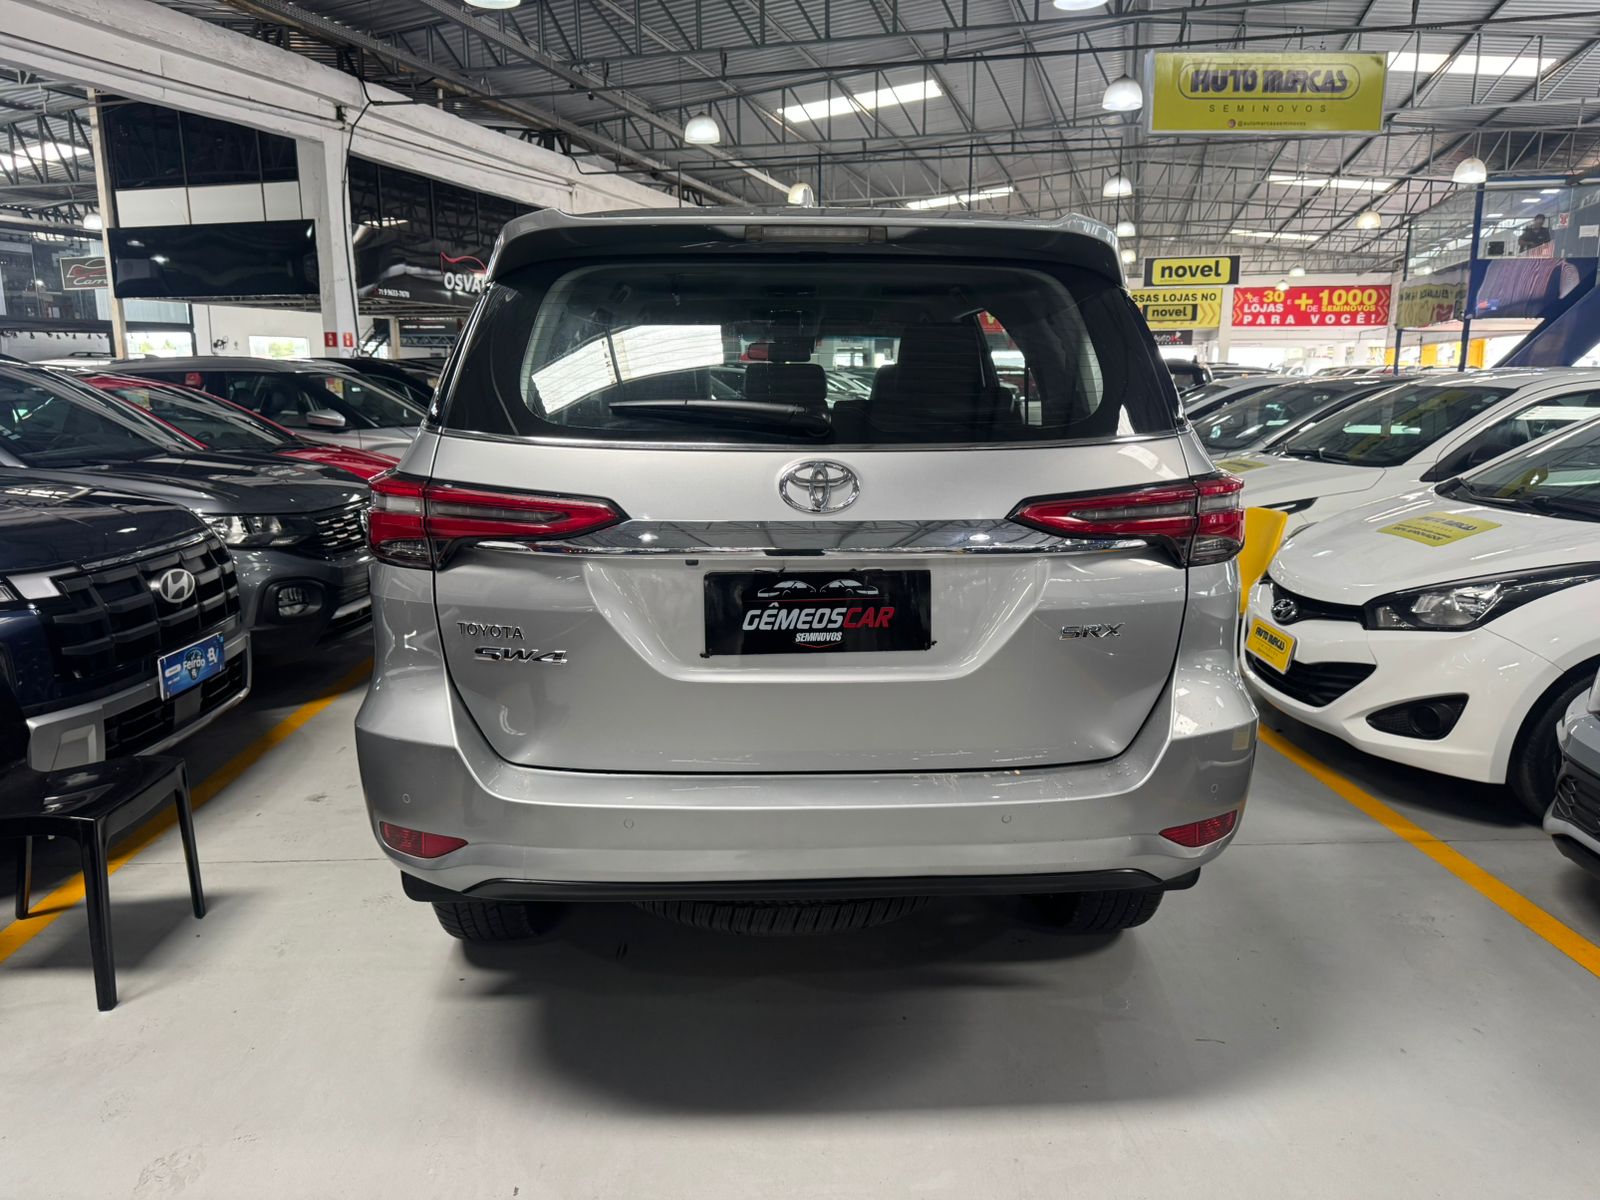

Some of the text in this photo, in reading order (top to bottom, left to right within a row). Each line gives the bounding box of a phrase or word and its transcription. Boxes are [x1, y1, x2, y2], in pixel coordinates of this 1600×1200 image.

[1190, 69, 1350, 93] AUTO MARCAS
[1209, 105, 1327, 113] SEMINOVOS
[1160, 260, 1222, 279] novel
[443, 272, 485, 293] OSVA
[1163, 293, 1198, 302] LOJAS
[1201, 293, 1217, 301] NO
[1263, 290, 1285, 303] 30
[1319, 289, 1377, 305] 1000
[1151, 307, 1187, 317] novel
[1244, 304, 1284, 312] LOJAS
[1321, 304, 1376, 312] SEMINOVOS
[1243, 312, 1376, 324] PARA VOCÊ!
[742, 602, 895, 631] GÊMEOSCAR
[457, 622, 524, 640] TOYOTA
[795, 632, 842, 642] SEMINOVOS
[1059, 622, 1126, 641] SRX
[474, 646, 568, 665] SW4
